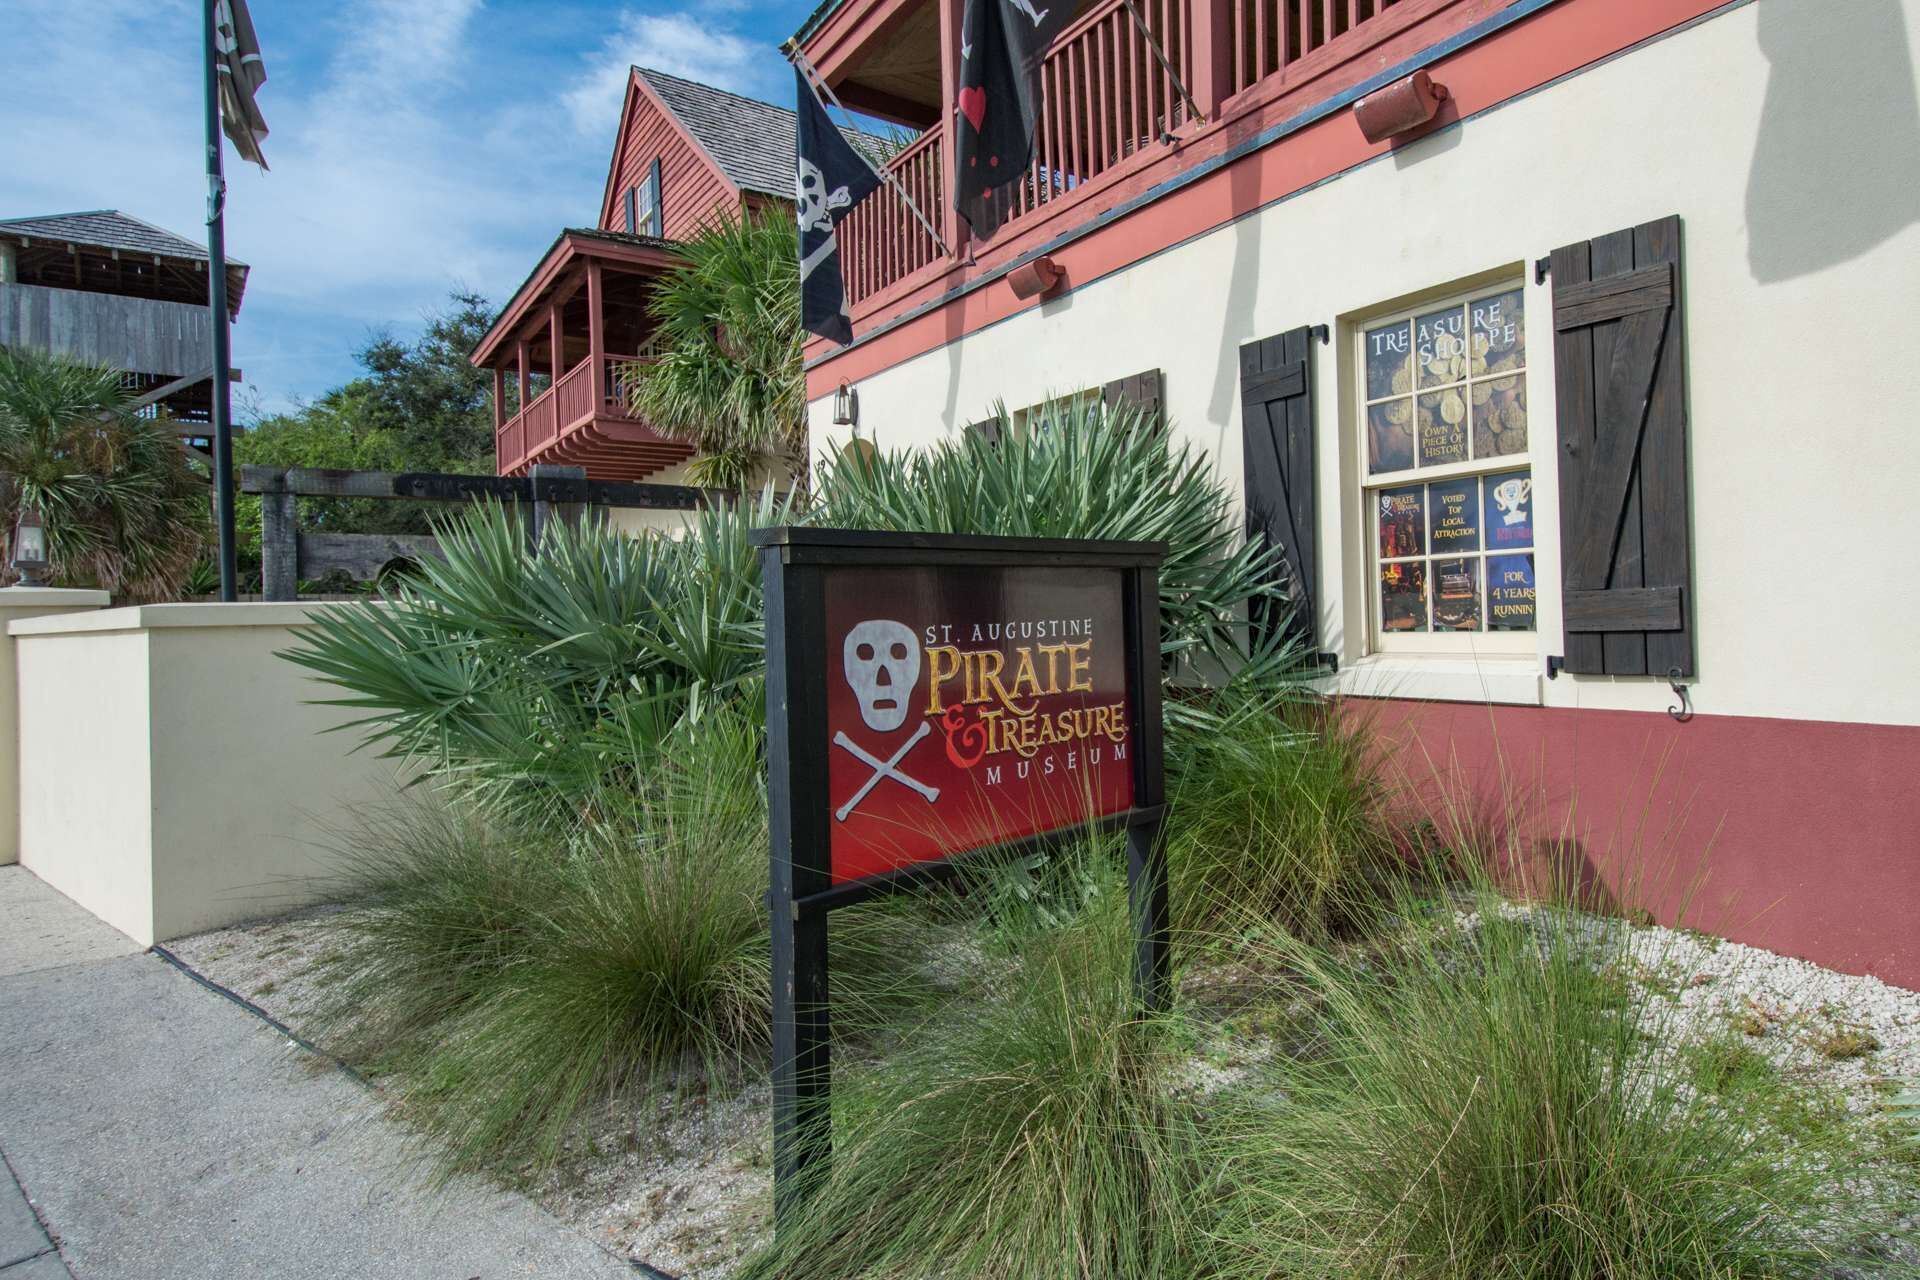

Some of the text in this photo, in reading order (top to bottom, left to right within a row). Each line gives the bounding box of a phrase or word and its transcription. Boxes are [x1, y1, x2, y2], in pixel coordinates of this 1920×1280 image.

[1372, 303, 1501, 355] TREASURE
[1420, 322, 1516, 366] SHOPPE
[1425, 426, 1448, 437] OWN
[1423, 432, 1464, 448] PIECE OF
[1425, 443, 1464, 457] HISTORY
[1442, 494, 1466, 504] VOTED
[1448, 505, 1462, 515] TOP
[1442, 517, 1465, 527] LOCAL
[1433, 527, 1476, 539] ATTRACTION
[1504, 571, 1529, 584] FOR
[1493, 587, 1536, 600] 4 YEARS
[1494, 604, 1536, 618] RUNNIN
[925, 618, 1093, 645] ST. AUGUSTINE
[924, 637, 1093, 717] PIRATE
[942, 701, 1129, 768] & TREASURE
[987, 743, 1127, 785] MUSEUM
